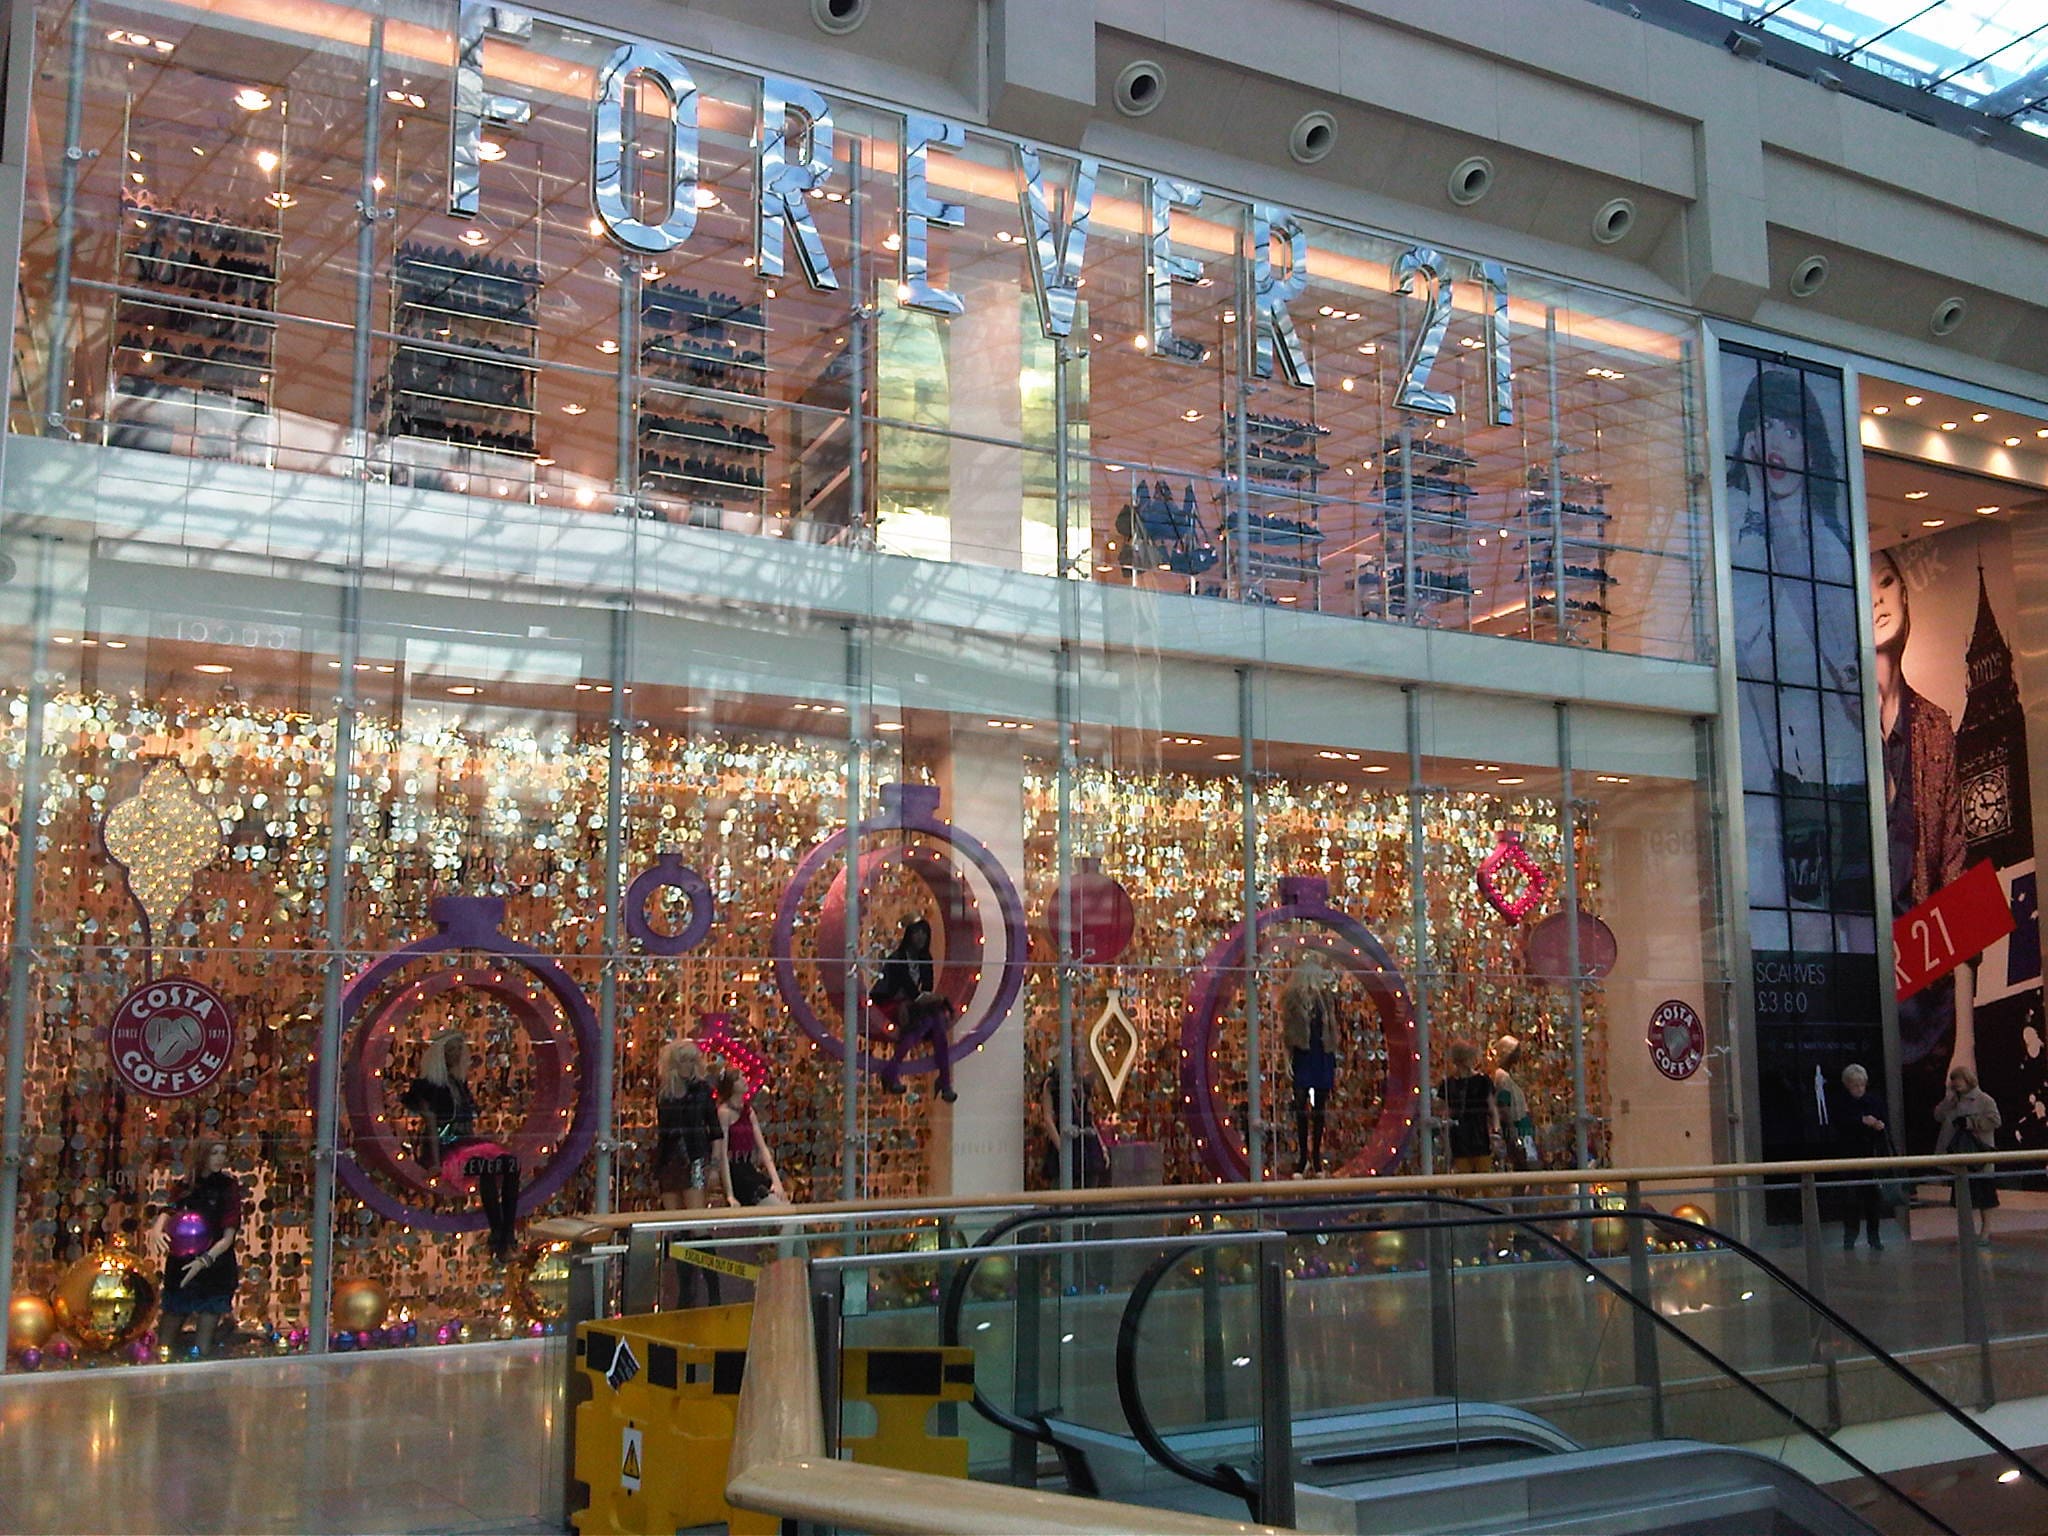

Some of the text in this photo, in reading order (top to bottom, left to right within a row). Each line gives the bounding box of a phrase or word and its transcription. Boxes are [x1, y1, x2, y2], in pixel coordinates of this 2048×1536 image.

[449, 0, 1512, 425] FOREVER 21
[1911, 907, 1955, 972] 21
[1756, 962, 1826, 985] SCARVES
[131, 986, 214, 1020] COSTA
[1655, 1006, 1693, 1027] COSTA
[122, 1050, 221, 1092] COFFEE
[1656, 1047, 1699, 1075] COFFEE
